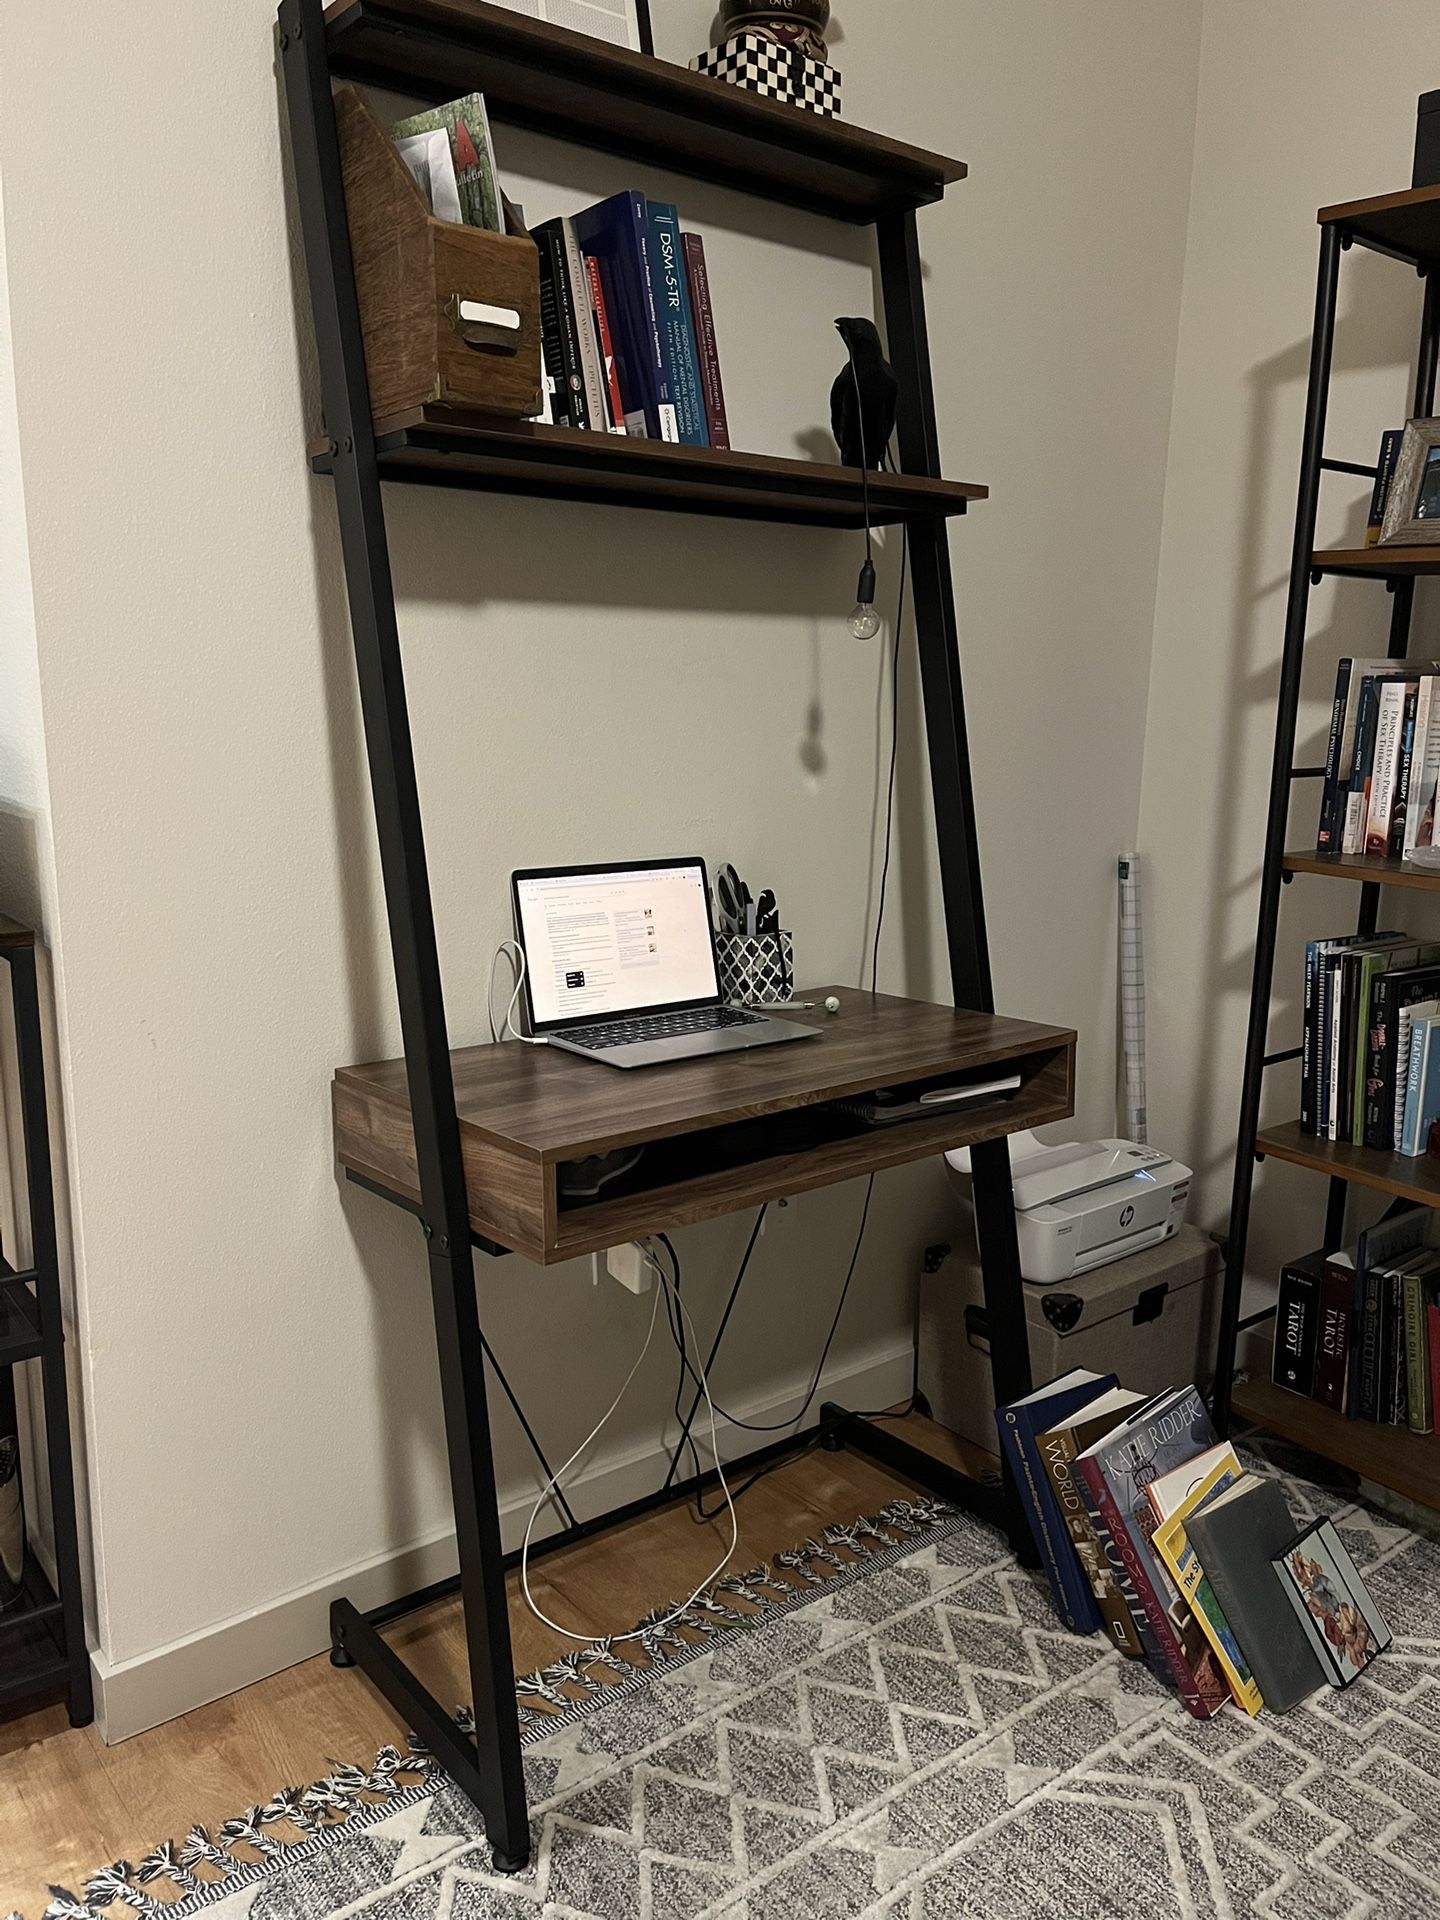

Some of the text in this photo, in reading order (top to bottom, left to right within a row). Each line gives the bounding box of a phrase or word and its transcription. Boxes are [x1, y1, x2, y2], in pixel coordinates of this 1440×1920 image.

[557, 258, 562, 267] TO
[558, 269, 566, 289] THINK
[572, 258, 584, 312] COMPLETE
[580, 318, 593, 355] WORKS
[695, 264, 710, 311] Selecting
[568, 340, 577, 369] EMPEROR
[652, 331, 663, 368] Psychotherapy
[665, 321, 674, 344] FIFTH
[702, 314, 716, 357] Effective
[669, 347, 678, 381] EDITION
[672, 319, 694, 435] MANUAL OF MENTAL DISORDERS
[679, 324, 701, 431] DIAGNOSTIC AND STATISTICAL
[709, 360, 723, 411] Treatments
[588, 365, 600, 417] EPICTETUS
[675, 402, 686, 434] REVISION
[1326, 698, 1340, 779] ABNORMAL PSYCHOLOGY
[1375, 710, 1388, 775] OF SEX THERAPY
[1386, 710, 1398, 757] PRINCIPLES
[1379, 780, 1390, 819] PRACTICE
[1399, 754, 1410, 799] SEX THERAPY
[1409, 1028, 1423, 1092] BREATHWORK
[1285, 1301, 1301, 1356] TAROT
[1323, 1308, 1338, 1357] TAROT
[1336, 1311, 1346, 1360] HOLISTIC
[1406, 1286, 1417, 1336] GRIMOIRE
[1407, 1341, 1417, 1364] GIRL
[1104, 1399, 1202, 1480] KATIE RIDDER
[1045, 1439, 1079, 1510] WORLD
[1021, 1461, 1045, 1521] Pashto-English
[1039, 1521, 1058, 1566] Dictionary
[1108, 1517, 1147, 1594] ROOMS
[1183, 1573, 1196, 1590] The
[1143, 1600, 1189, 1684] KATIE RIDDER
